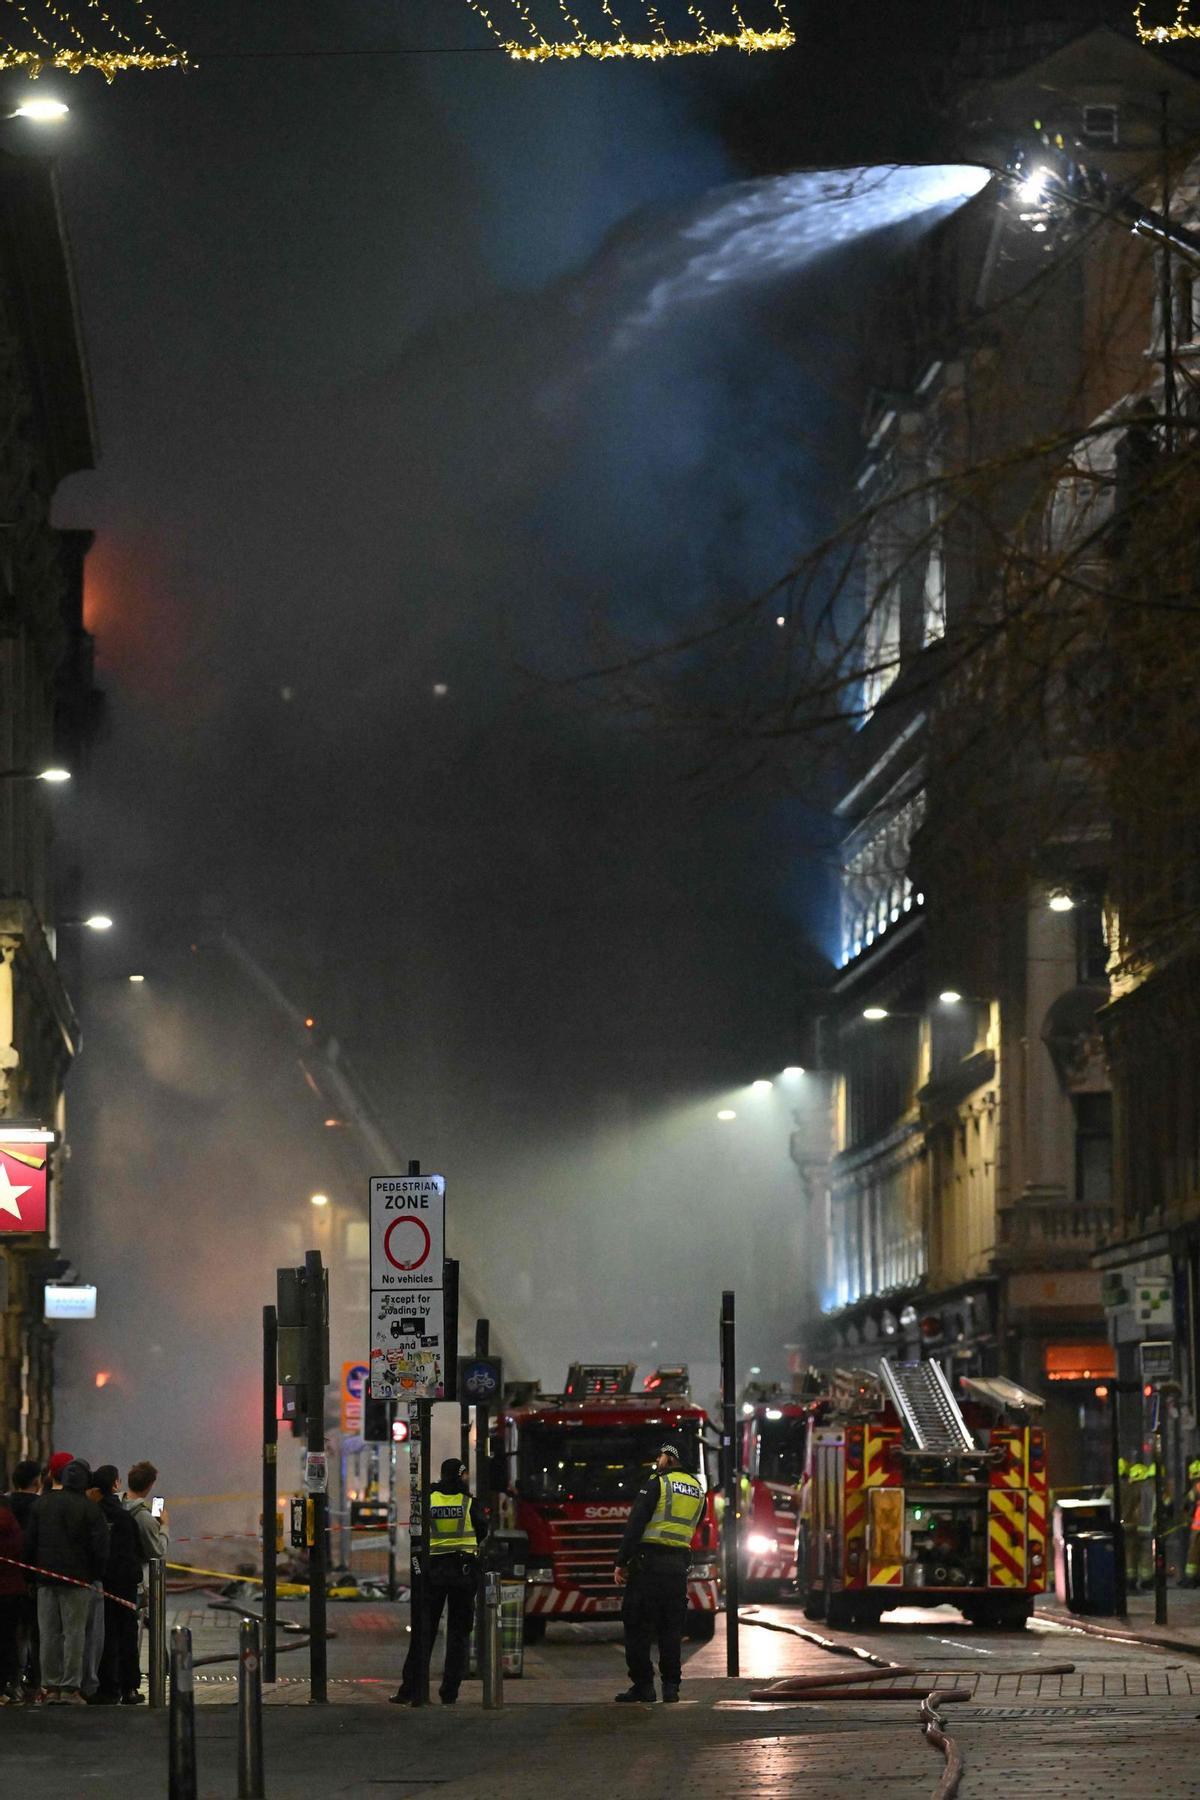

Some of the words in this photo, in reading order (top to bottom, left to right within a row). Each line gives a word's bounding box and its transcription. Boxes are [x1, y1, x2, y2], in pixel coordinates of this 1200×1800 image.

[376, 1182, 438, 1192] PEDESTRIAN
[385, 1195, 429, 1209] ZONE
[382, 1275, 395, 1284] No
[397, 1274, 434, 1284] vehicles
[417, 1294, 431, 1303] for
[419, 1306, 431, 1316] by
[399, 1341, 416, 1350] and
[672, 1482, 700, 1498] POLICE
[431, 1507, 464, 1518] POLICE
